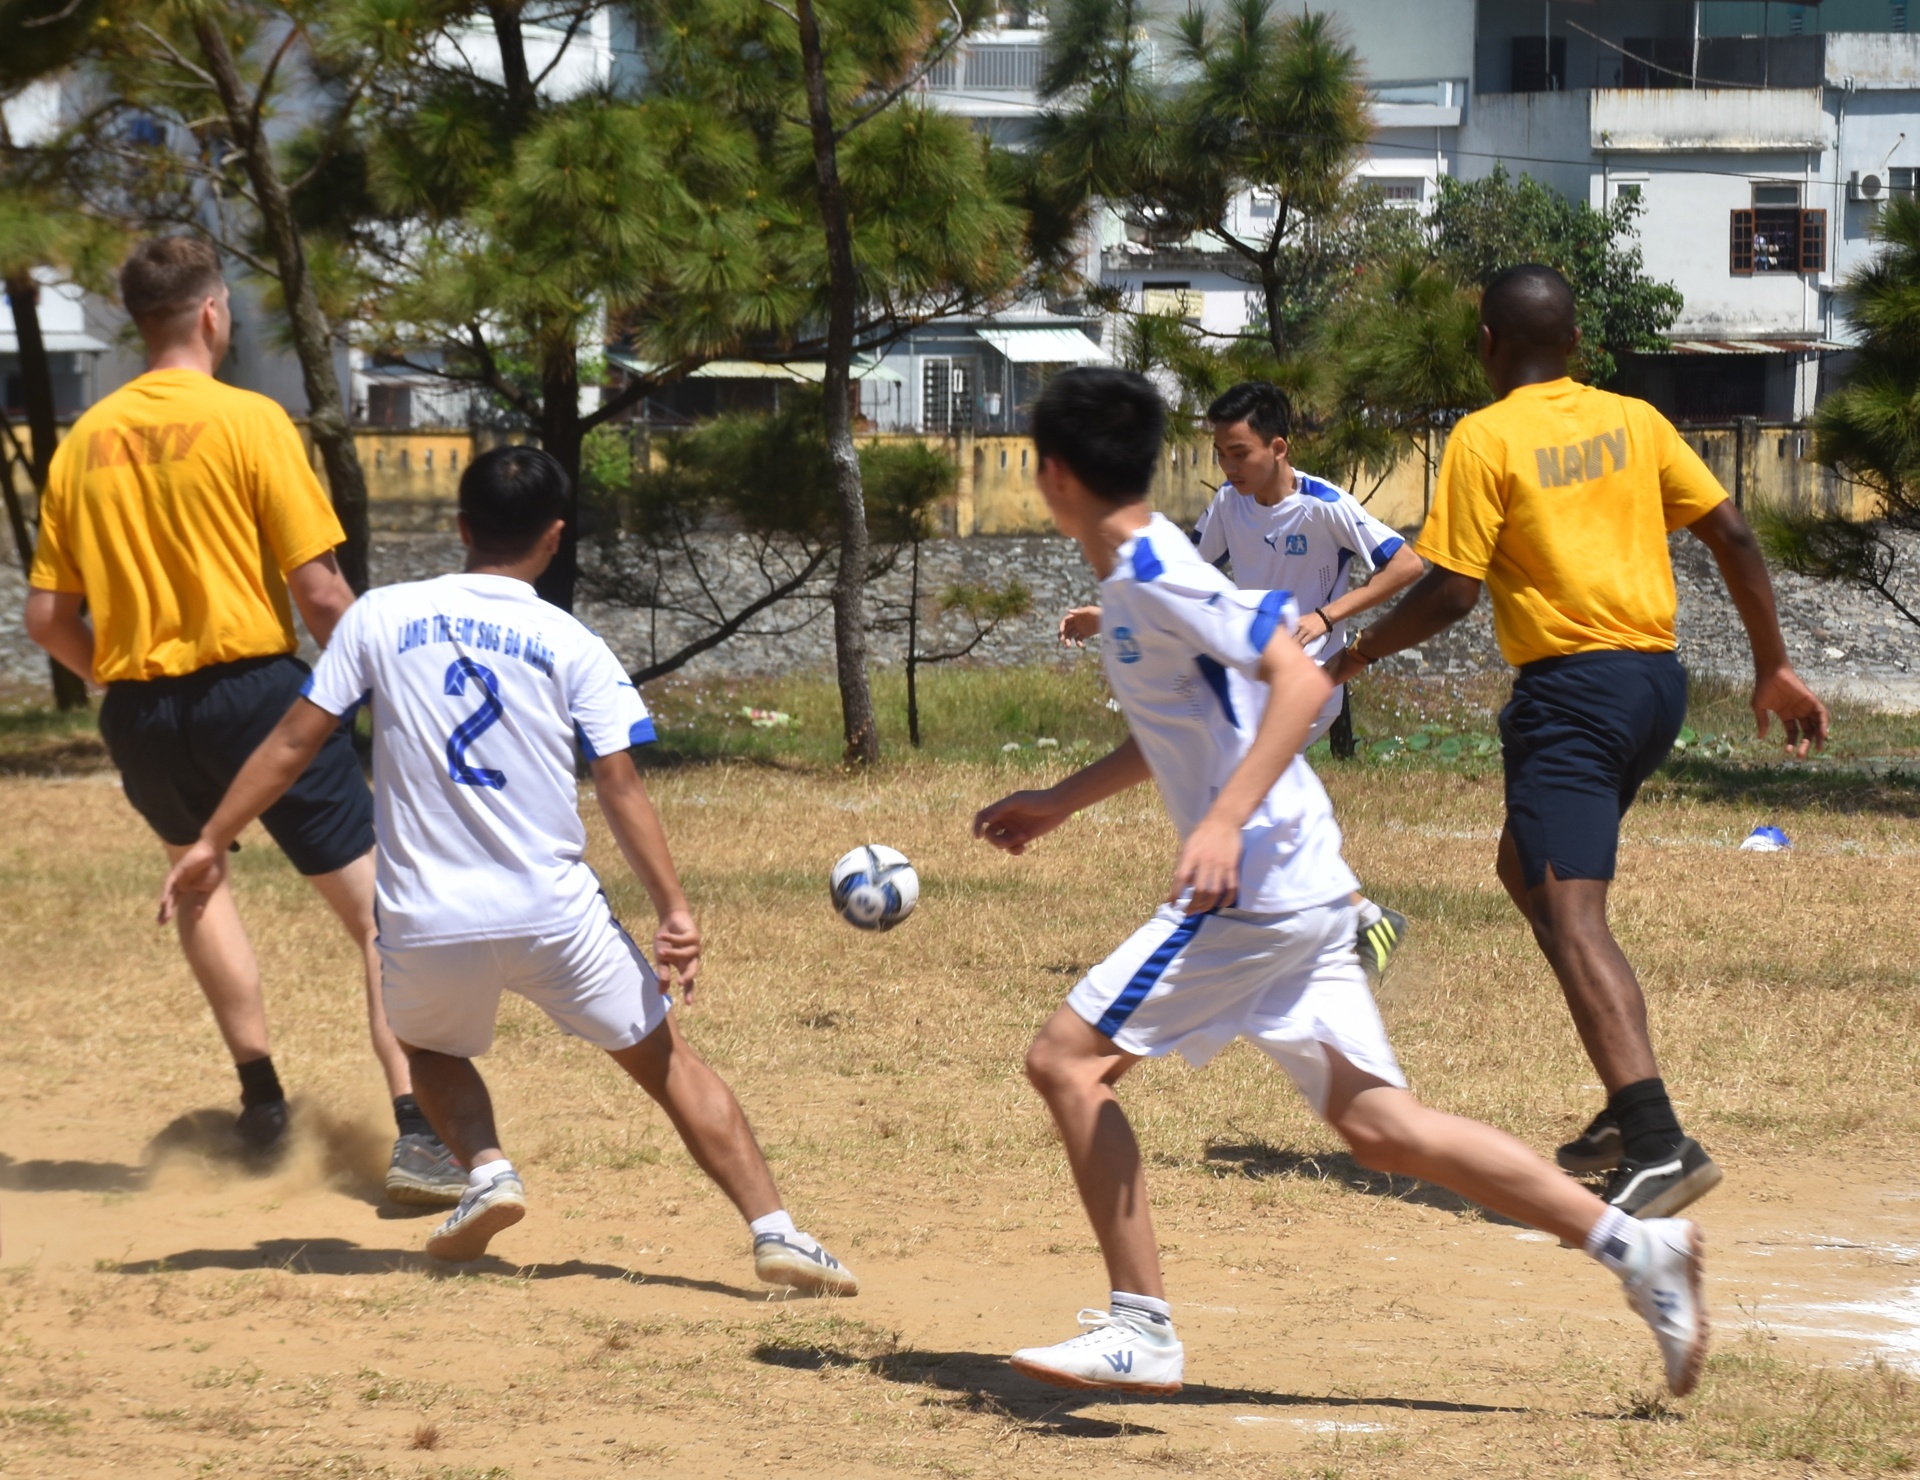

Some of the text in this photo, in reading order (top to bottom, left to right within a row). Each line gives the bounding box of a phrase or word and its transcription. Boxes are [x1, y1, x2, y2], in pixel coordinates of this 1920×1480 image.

[87, 421, 207, 472] NAVY
[1535, 428, 1627, 488] NAVY
[477, 621, 502, 652] SOS
[444, 656, 507, 790] 2
